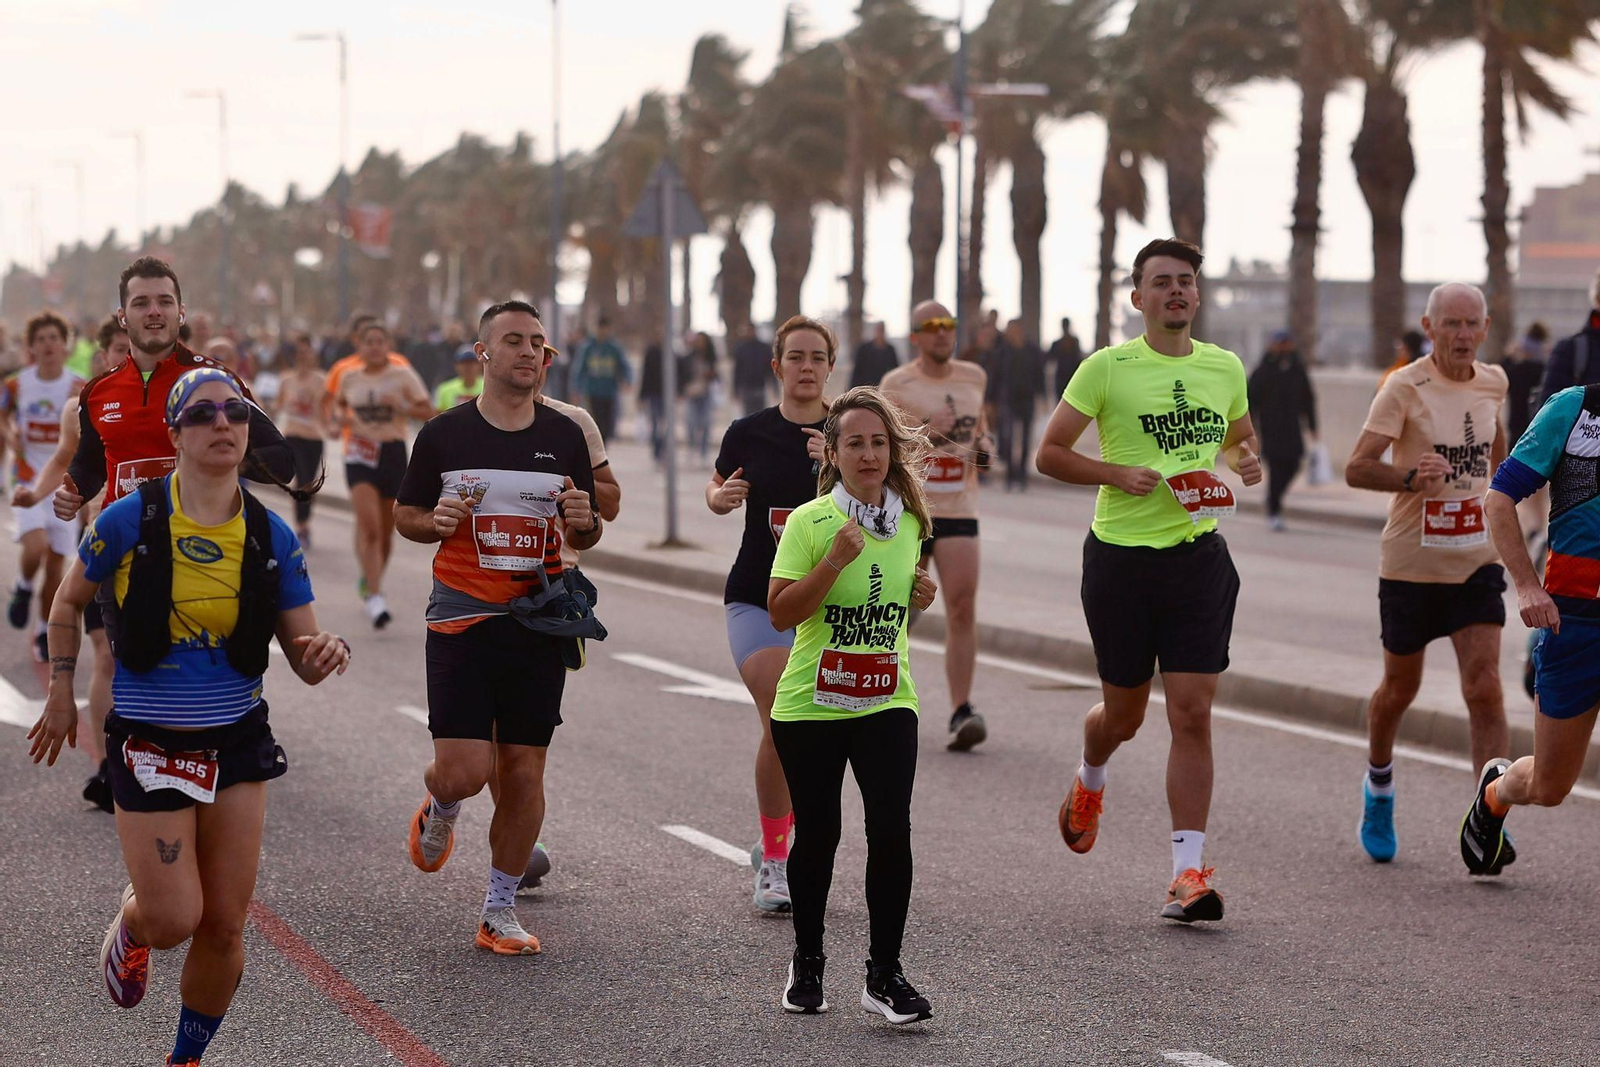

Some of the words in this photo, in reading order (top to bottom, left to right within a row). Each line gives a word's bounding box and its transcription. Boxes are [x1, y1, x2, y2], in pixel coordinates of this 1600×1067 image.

[102, 402, 120, 411] JAKO
[1138, 407, 1225, 434] BRUNCH
[1153, 427, 1195, 455] RUN
[1203, 486, 1228, 499] 240
[477, 531, 510, 541] BRUNCH
[515, 534, 538, 549] 291
[824, 602, 907, 628] BRUNCH
[830, 622, 874, 650] RUN
[821, 667, 857, 681] BRUNCH
[824, 675, 842, 686] RUN
[862, 674, 891, 688] 210
[174, 758, 207, 779] 955
